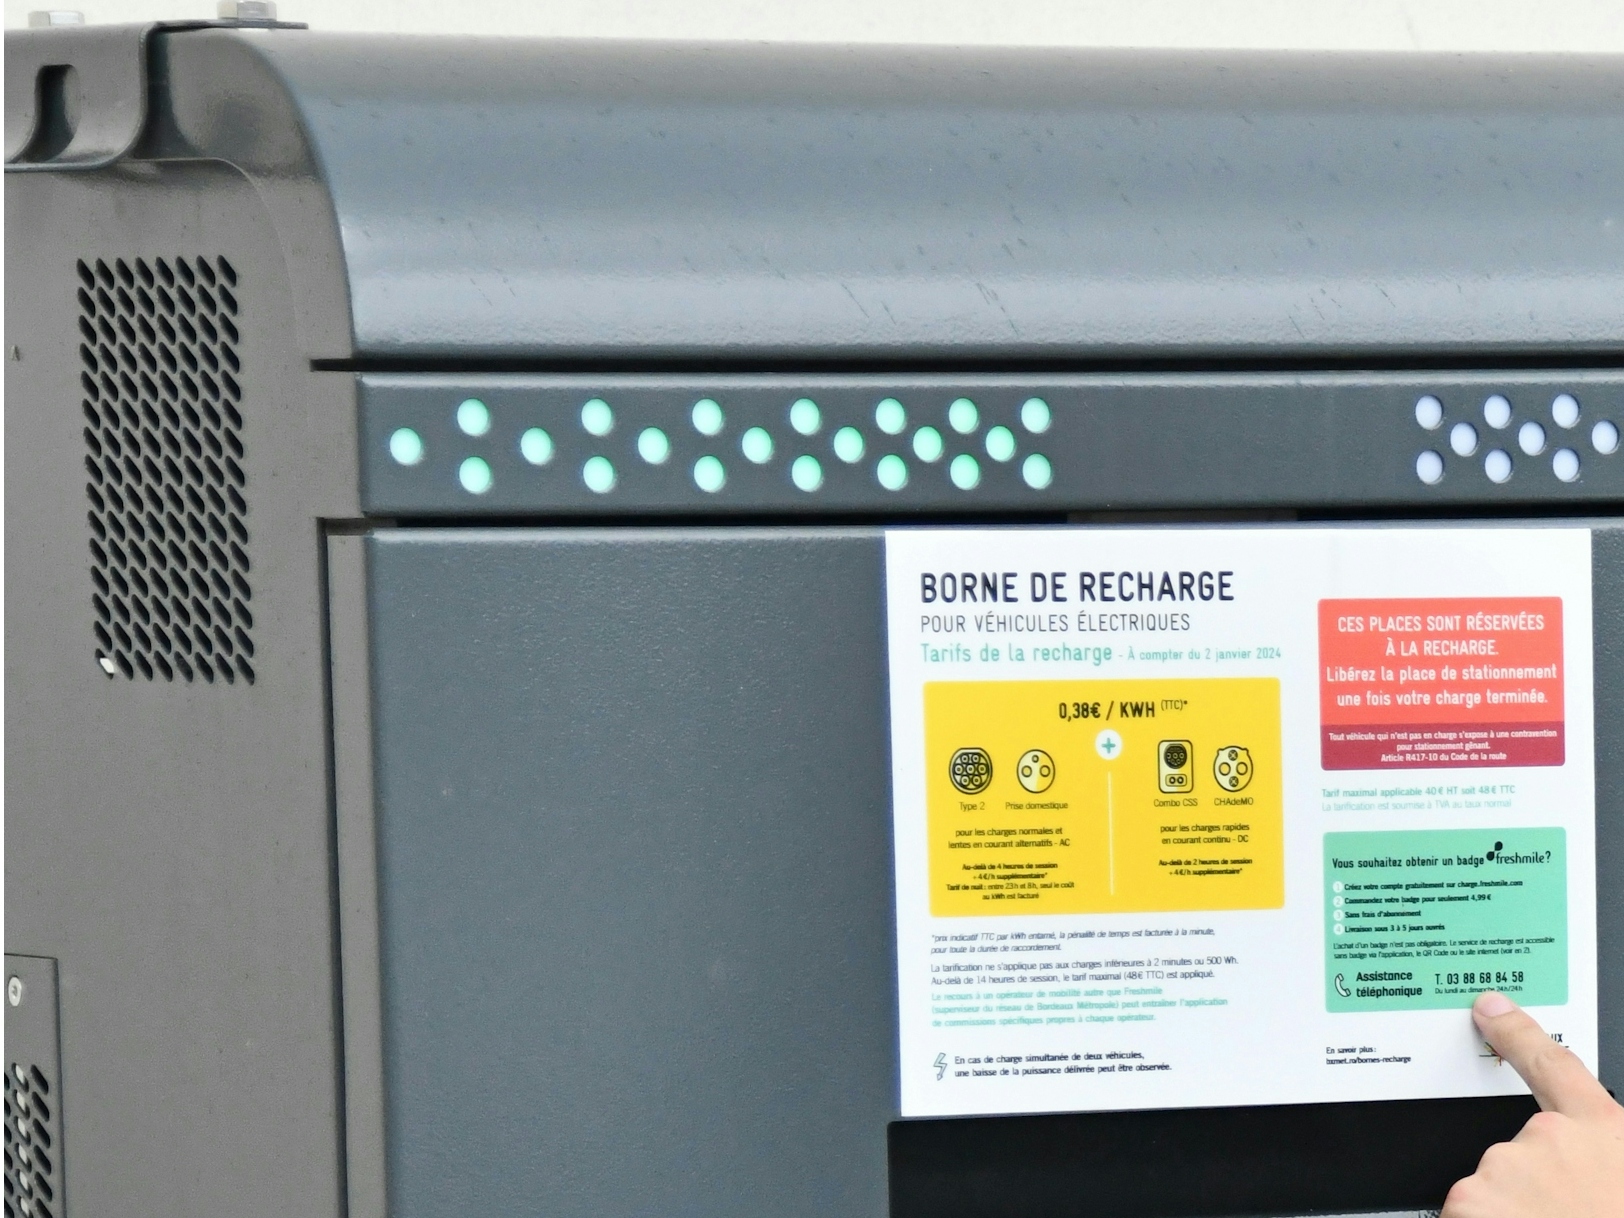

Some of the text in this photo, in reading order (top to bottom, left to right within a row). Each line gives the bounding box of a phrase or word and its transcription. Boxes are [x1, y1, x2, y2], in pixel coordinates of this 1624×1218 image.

[921, 571, 1234, 603] BORNE DE RECHARGE
[921, 610, 1190, 632] POUR VÉHICULES ÉLECTRIQUES
[1338, 611, 1544, 632] CES PLACES SONT RÉSERVÉES
[1386, 637, 1499, 656] À LA RECHARGE.
[921, 643, 971, 662] Tarifs
[980, 643, 1000, 662] de
[1008, 642, 1025, 661] la
[1033, 642, 1112, 666] recharge
[1128, 646, 1135, 660] À
[1139, 650, 1183, 662] compter
[1188, 648, 1200, 660] du
[1205, 648, 1211, 659] 2
[1215, 648, 1252, 662] janvier
[1256, 648, 1281, 659] 2024
[1326, 664, 1557, 684] Libérez la place de stationnement
[1337, 688, 1548, 708] une fois votre charge terminée.
[1059, 702, 1101, 722] 0,38€
[1106, 701, 1114, 720] /
[1120, 701, 1155, 717] KWH
[1346, 732, 1375, 740] véhicule
[1377, 732, 1388, 741] qui
[1390, 732, 1408, 740] n'est
[1409, 733, 1421, 741] pas
[1434, 731, 1457, 740] charge
[1490, 730, 1494, 738] à
[1414, 742, 1463, 750] stationnement
[1465, 741, 1490, 749] gênant.
[1381, 754, 1404, 762] Article
[1405, 753, 1438, 761] R417-10
[1439, 753, 1449, 761] du
[1480, 752, 1487, 760] la
[1006, 802, 1068, 810] Prise domestique
[1154, 798, 1198, 807] Combo CSS
[1214, 797, 1253, 805] CHAdeMO
[959, 802, 985, 812] Type 2
[956, 829, 972, 837] pour
[975, 828, 985, 836] les
[987, 829, 1016, 837] charges
[1019, 827, 1053, 835] normales
[1160, 823, 1250, 833] pour les charges rapides
[1172, 836, 1200, 844] courant
[1238, 835, 1248, 843] DC
[1332, 858, 1354, 868] Vous
[1358, 857, 1402, 867] souhaitez
[1406, 856, 1438, 866] obtenir
[1457, 855, 1484, 868] badge
[1356, 971, 1413, 982] Assistance
[1447, 973, 1458, 984] 03
[1463, 973, 1475, 983] 88
[1480, 972, 1491, 983] 68
[1496, 972, 1507, 983] 84
[1512, 971, 1524, 982] 58
[1356, 986, 1422, 998] téléphonique
[996, 1055, 1023, 1064] charge
[1026, 1054, 1069, 1062] simultanée
[1072, 1053, 1081, 1061] de
